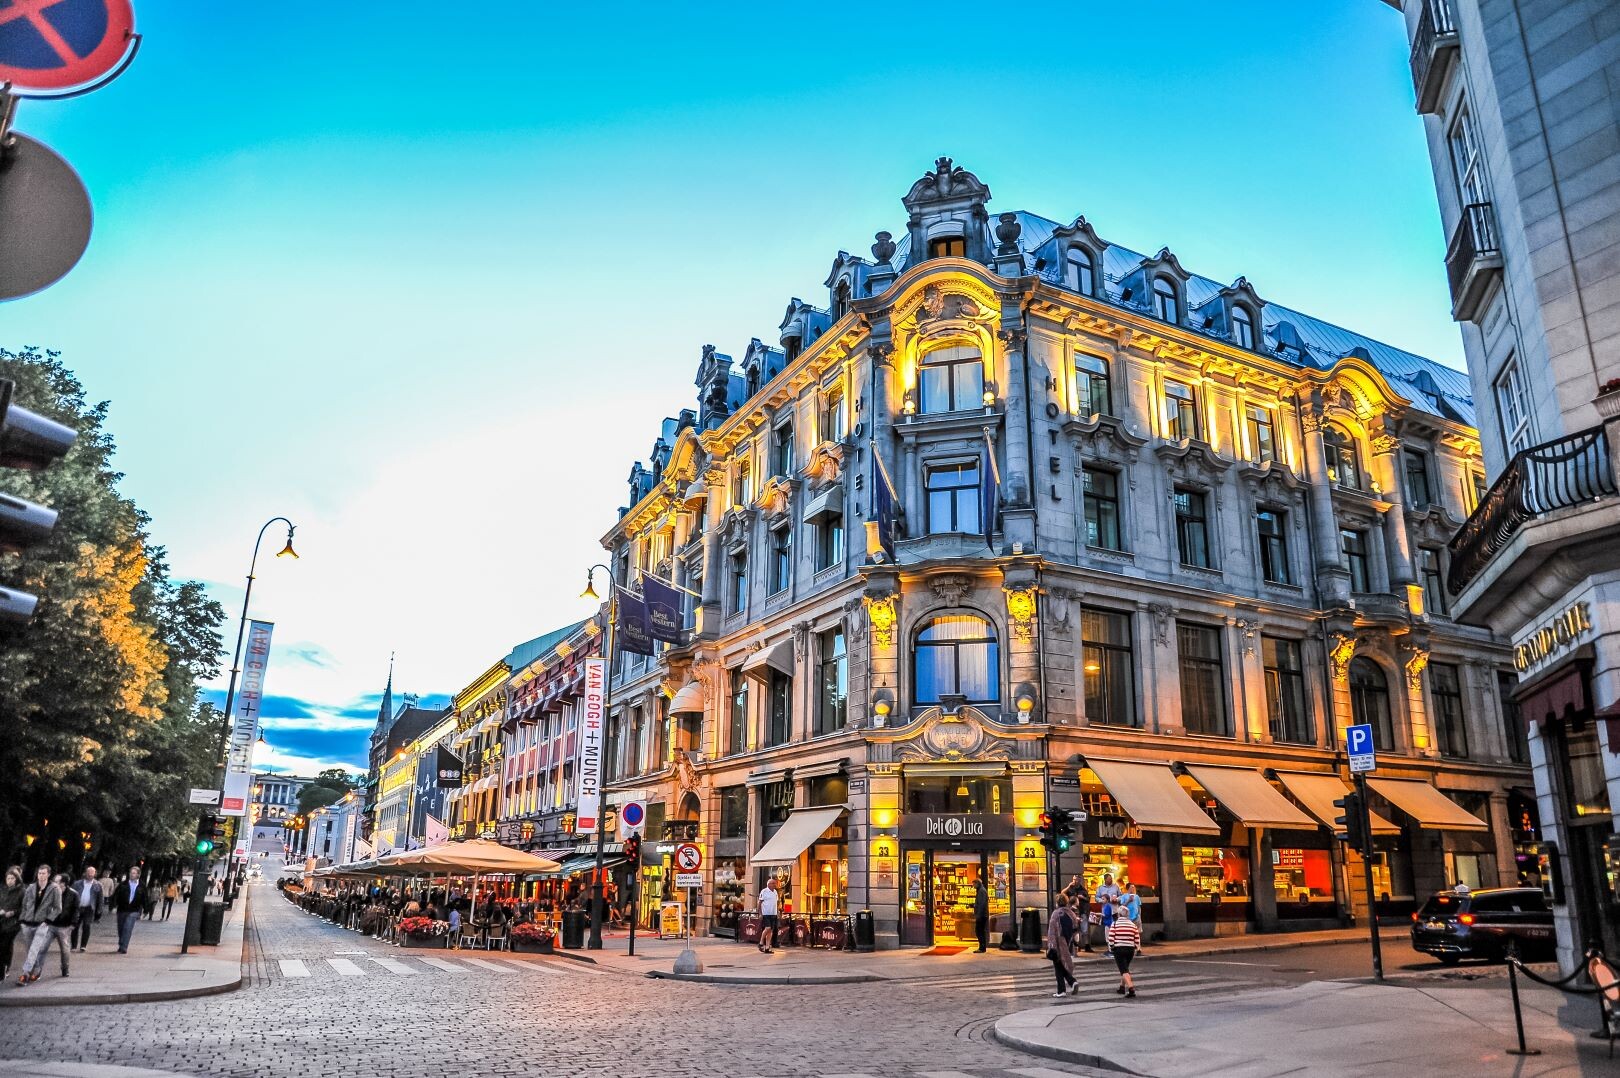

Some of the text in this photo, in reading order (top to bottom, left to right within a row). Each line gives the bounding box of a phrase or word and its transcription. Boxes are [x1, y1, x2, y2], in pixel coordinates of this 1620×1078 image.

[1046, 375, 1061, 501] HOTEL
[854, 395, 864, 517] HOTEL
[653, 609, 668, 620] Best
[1513, 627, 1553, 672] GRAND
[588, 664, 602, 689] VAN
[1352, 729, 1366, 752] P
[926, 817, 983, 836] Deli de Luca
[878, 846, 889, 857] 33
[1024, 847, 1036, 858] 33
